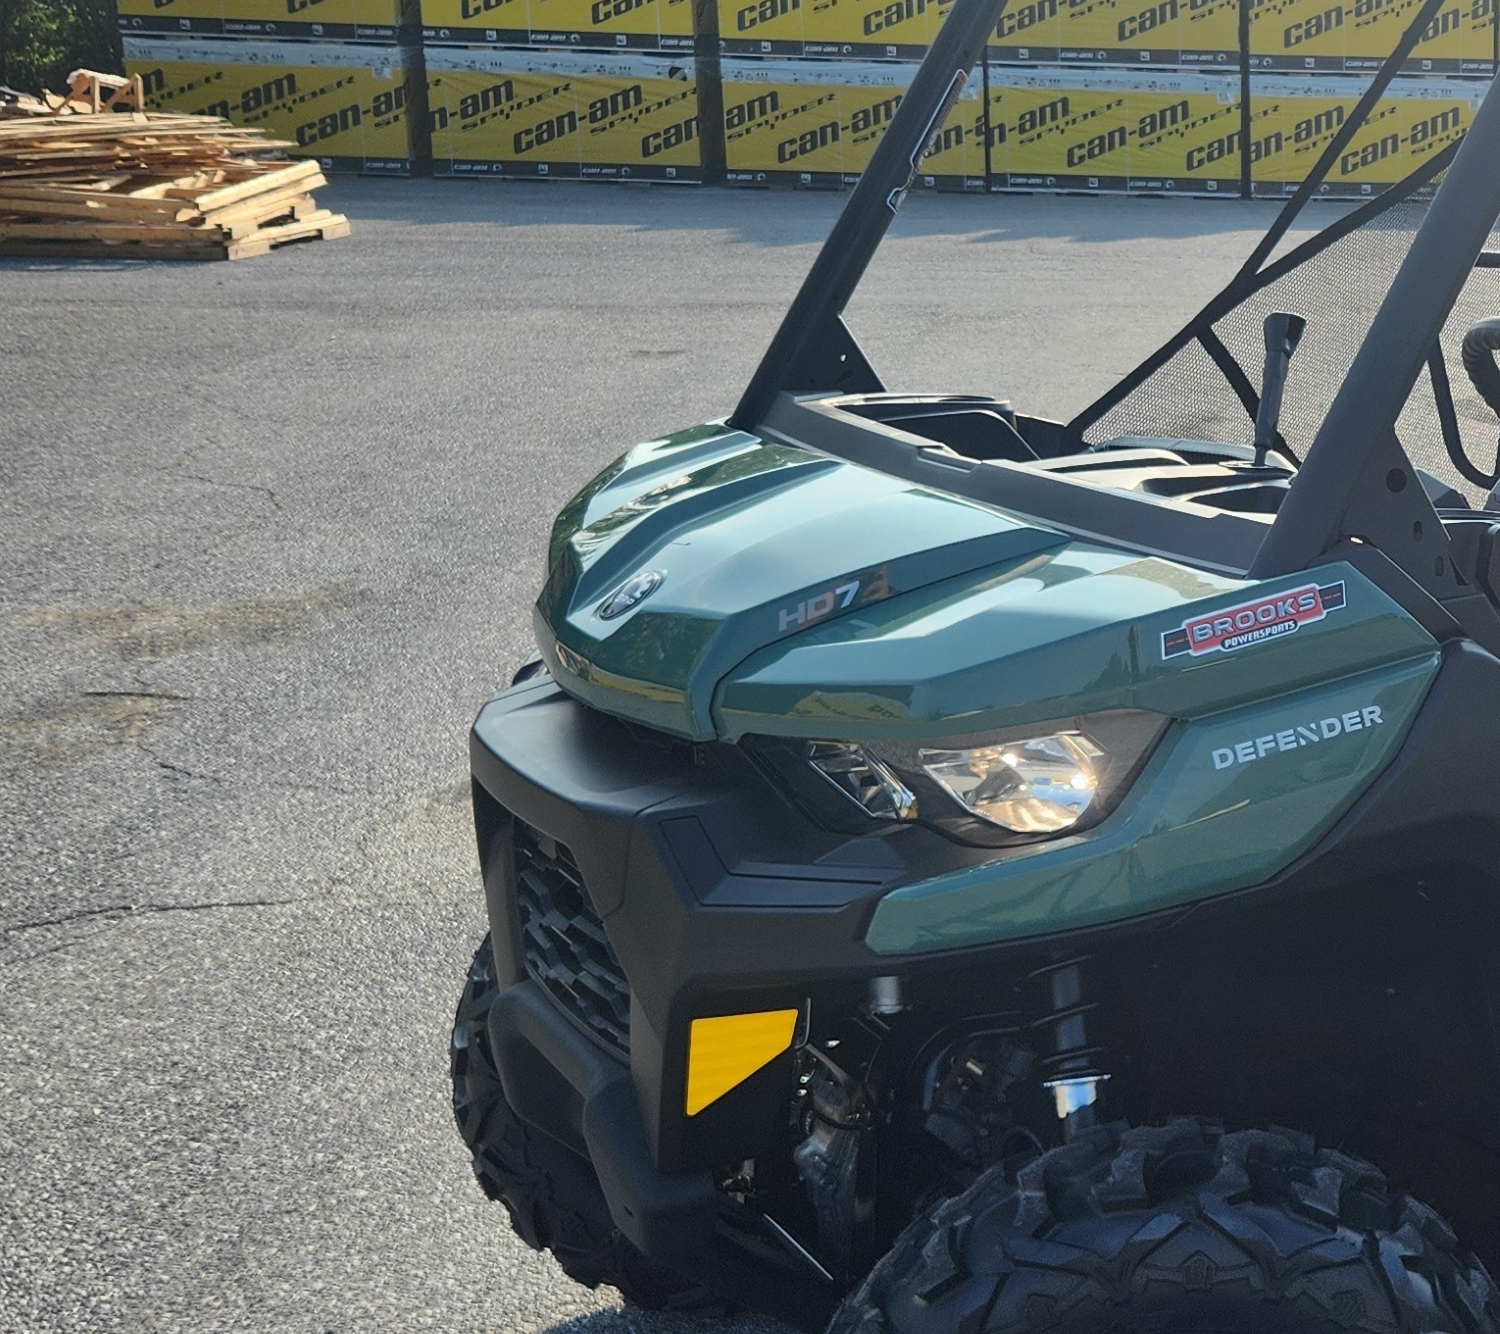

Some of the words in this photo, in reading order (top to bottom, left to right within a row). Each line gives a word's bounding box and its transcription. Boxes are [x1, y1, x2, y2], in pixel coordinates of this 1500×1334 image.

[427, 79, 514, 134] n-am
[461, 82, 571, 133] SPYDER
[513, 84, 643, 155] can-am
[727, 93, 835, 143] SPYDER
[1019, 99, 1123, 147] SPYDER
[641, 116, 699, 158] can
[1067, 100, 1189, 169] can-am
[1186, 130, 1241, 172] can
[1251, 105, 1344, 164] an-am
[1341, 107, 1460, 176] can-am
[778, 580, 861, 633] HD7
[1192, 592, 1318, 643] BROOKS
[1224, 620, 1296, 649] POWERSPORTS
[1212, 705, 1384, 770] DEFENDER
